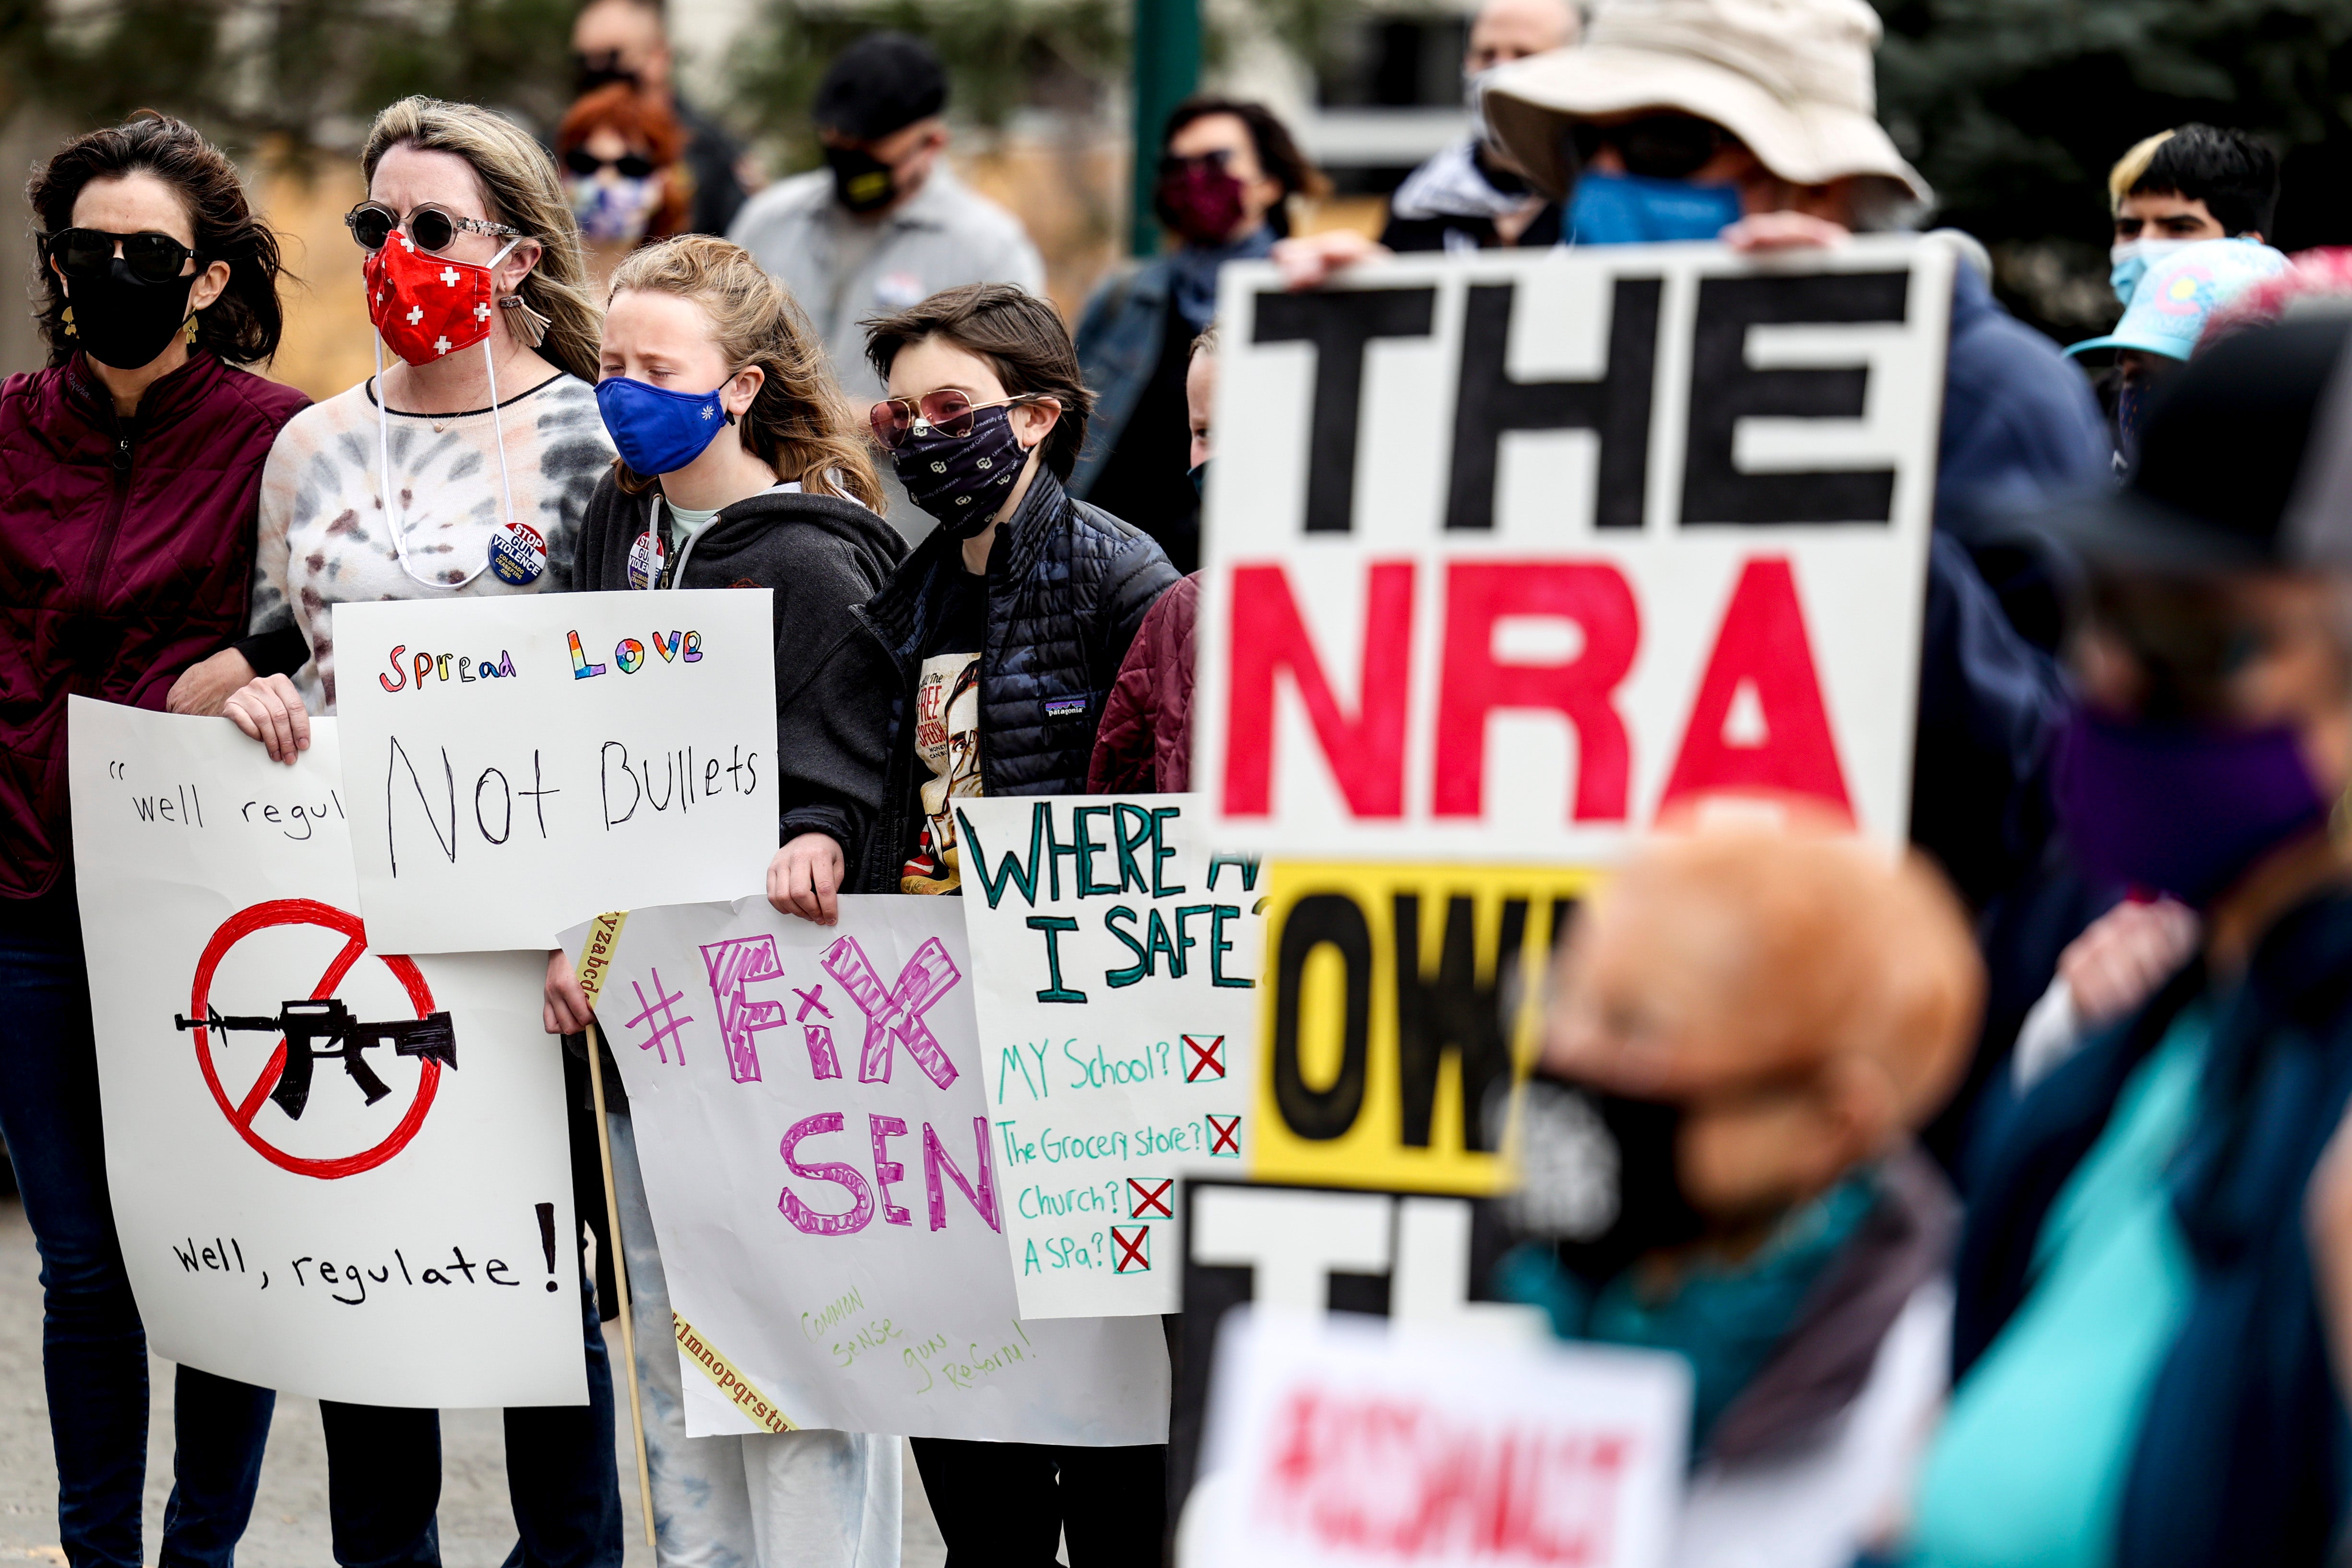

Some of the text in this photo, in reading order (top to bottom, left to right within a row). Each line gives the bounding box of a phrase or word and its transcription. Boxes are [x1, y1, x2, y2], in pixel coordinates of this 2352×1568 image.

[1250, 269, 1912, 535] THE
[947, 447, 970, 463] University
[938, 477, 961, 492] Colorado
[511, 536, 535, 558] GUN
[513, 523, 543, 548] STOP
[494, 535, 540, 576] VIOLENCE
[495, 558, 523, 580] CEASEFIRE
[499, 554, 524, 574] COLORADO
[930, 673, 943, 684] The
[1218, 552, 1861, 831] NRA
[917, 685, 942, 723] FREE
[1048, 707, 1083, 717] patagonia
[917, 721, 948, 747] SPEECH
[929, 744, 947, 752] MONEY
[601, 741, 758, 832] Bullets
[956, 801, 1186, 909] WHERE
[1026, 916, 1087, 1003] I
[1064, 1038, 1170, 1088] School?
[996, 1120, 1036, 1166] The
[1025, 1238, 1041, 1276] A
